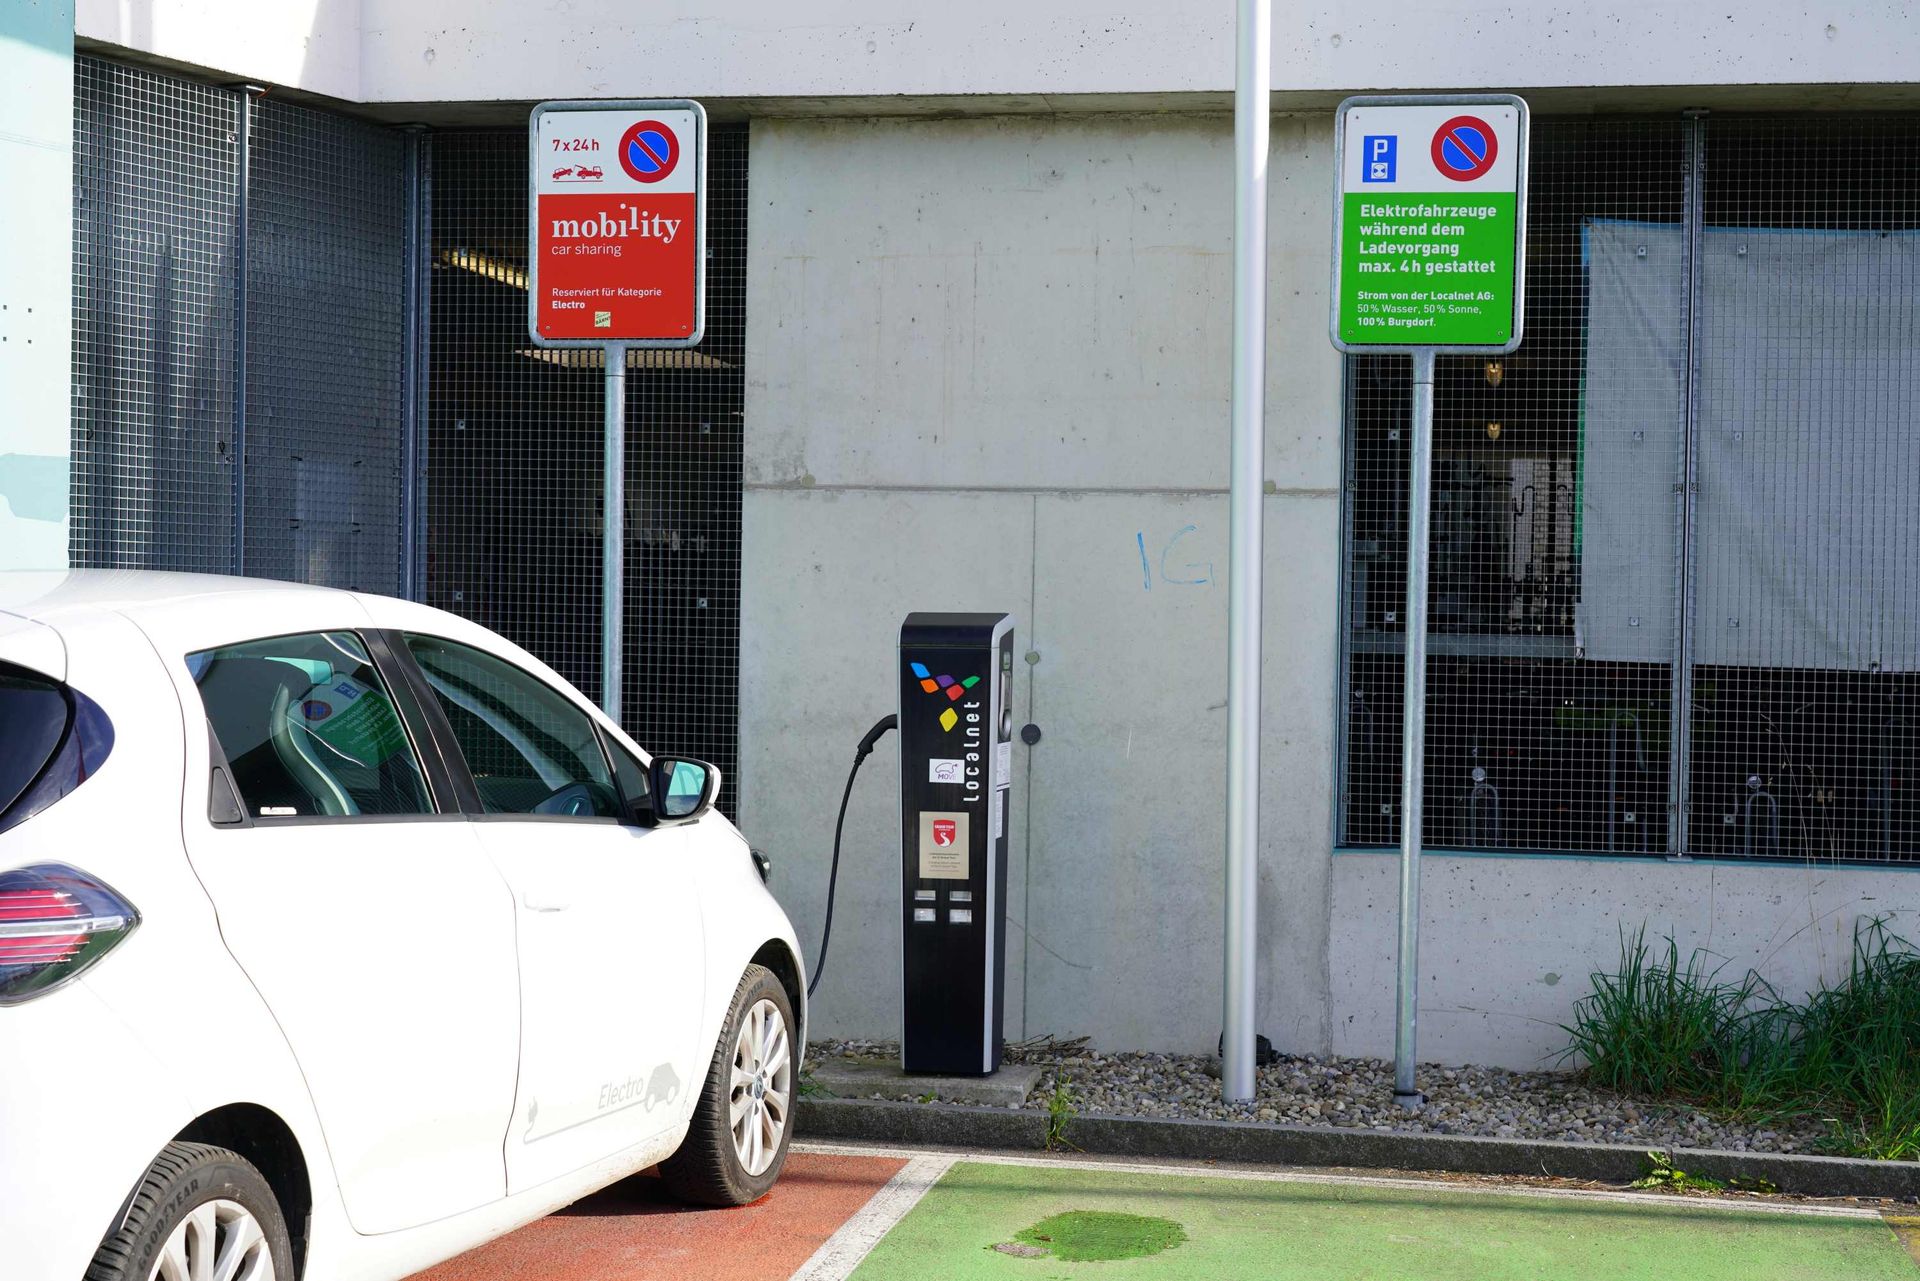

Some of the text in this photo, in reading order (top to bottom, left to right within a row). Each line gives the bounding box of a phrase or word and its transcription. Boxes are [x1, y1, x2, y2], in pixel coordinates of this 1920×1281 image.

[552, 139, 560, 151] 7
[573, 139, 589, 151] 24
[592, 138, 600, 151] h
[1373, 139, 1388, 161] P
[1360, 204, 1497, 220] Elektrofahrzeuge
[552, 203, 682, 244] mobility
[1359, 222, 1465, 236] während dem
[551, 243, 622, 257] car sharing
[1359, 241, 1460, 257] Ladevorgang
[1358, 261, 1396, 273] max.
[1425, 260, 1496, 276] gestattet
[552, 287, 662, 298] Reserviert für Kategorie
[1357, 291, 1495, 300] Strom von der Localnet AG:
[552, 300, 586, 309] Electro
[1381, 303, 1421, 315] Wasser,
[1448, 304, 1482, 315] Sonne,
[1388, 317, 1437, 328] Burgdorf.
[963, 701, 980, 802] localnet
[598, 1076, 644, 1110] Electro
